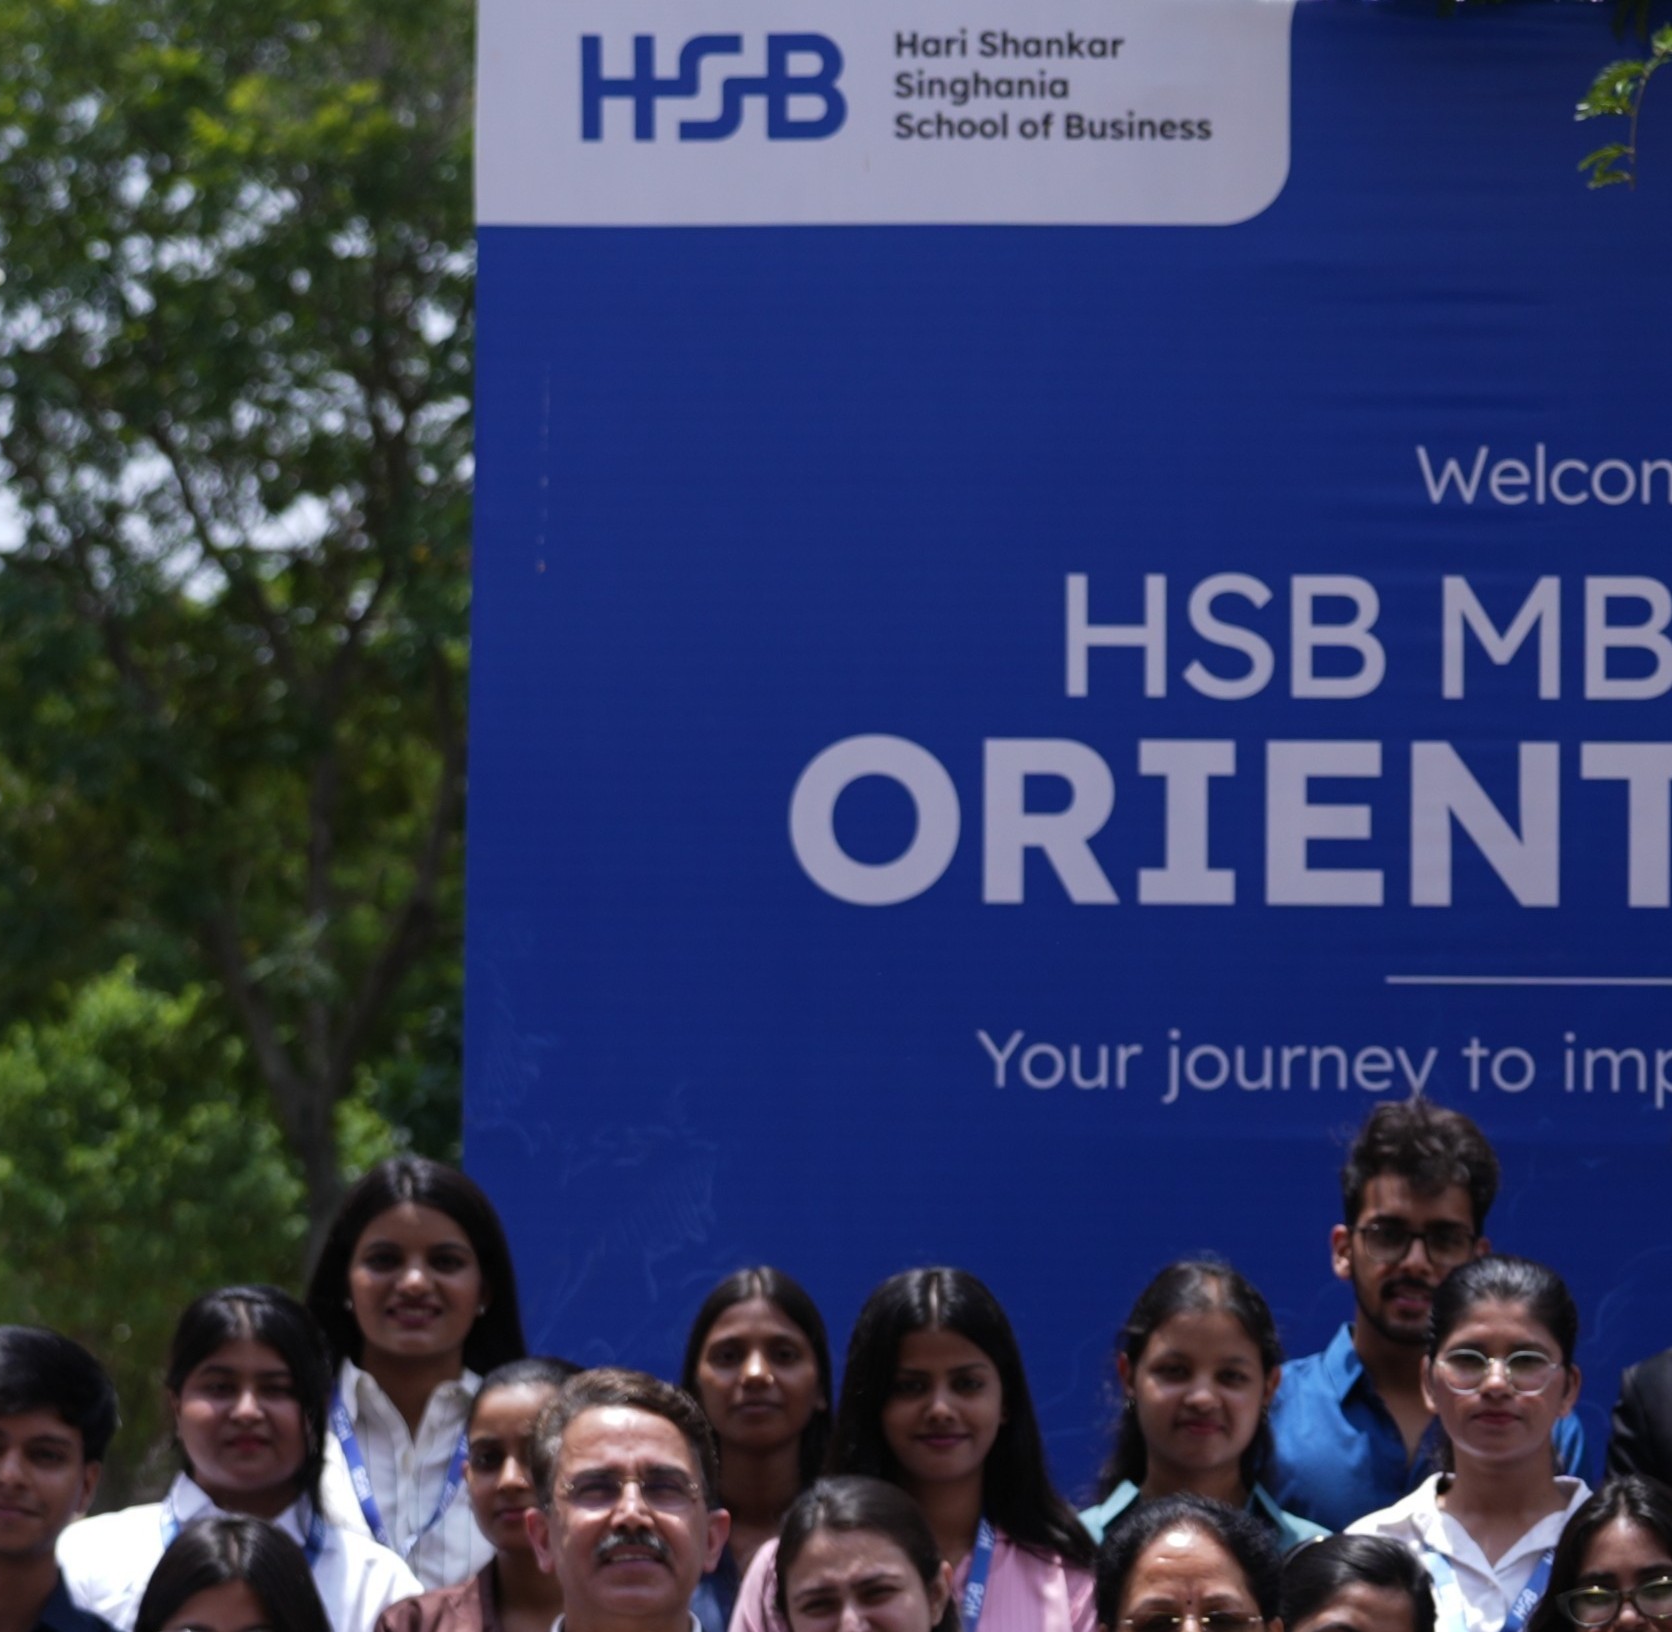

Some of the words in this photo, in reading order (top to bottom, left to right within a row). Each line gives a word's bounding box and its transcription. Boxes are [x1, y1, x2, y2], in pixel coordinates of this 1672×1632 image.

[894, 29, 968, 58] Hari
[978, 31, 1125, 59] Shankar
[581, 33, 846, 141] HSB
[894, 69, 1069, 106] Singhania
[894, 112, 1008, 140] School
[1018, 112, 1054, 140] of
[1064, 111, 1213, 140] Business
[1066, 573, 1386, 700] HSB
[977, 1029, 1142, 1090] Your
[1162, 1028, 1437, 1104] journey
[1461, 1037, 1536, 1093] to
